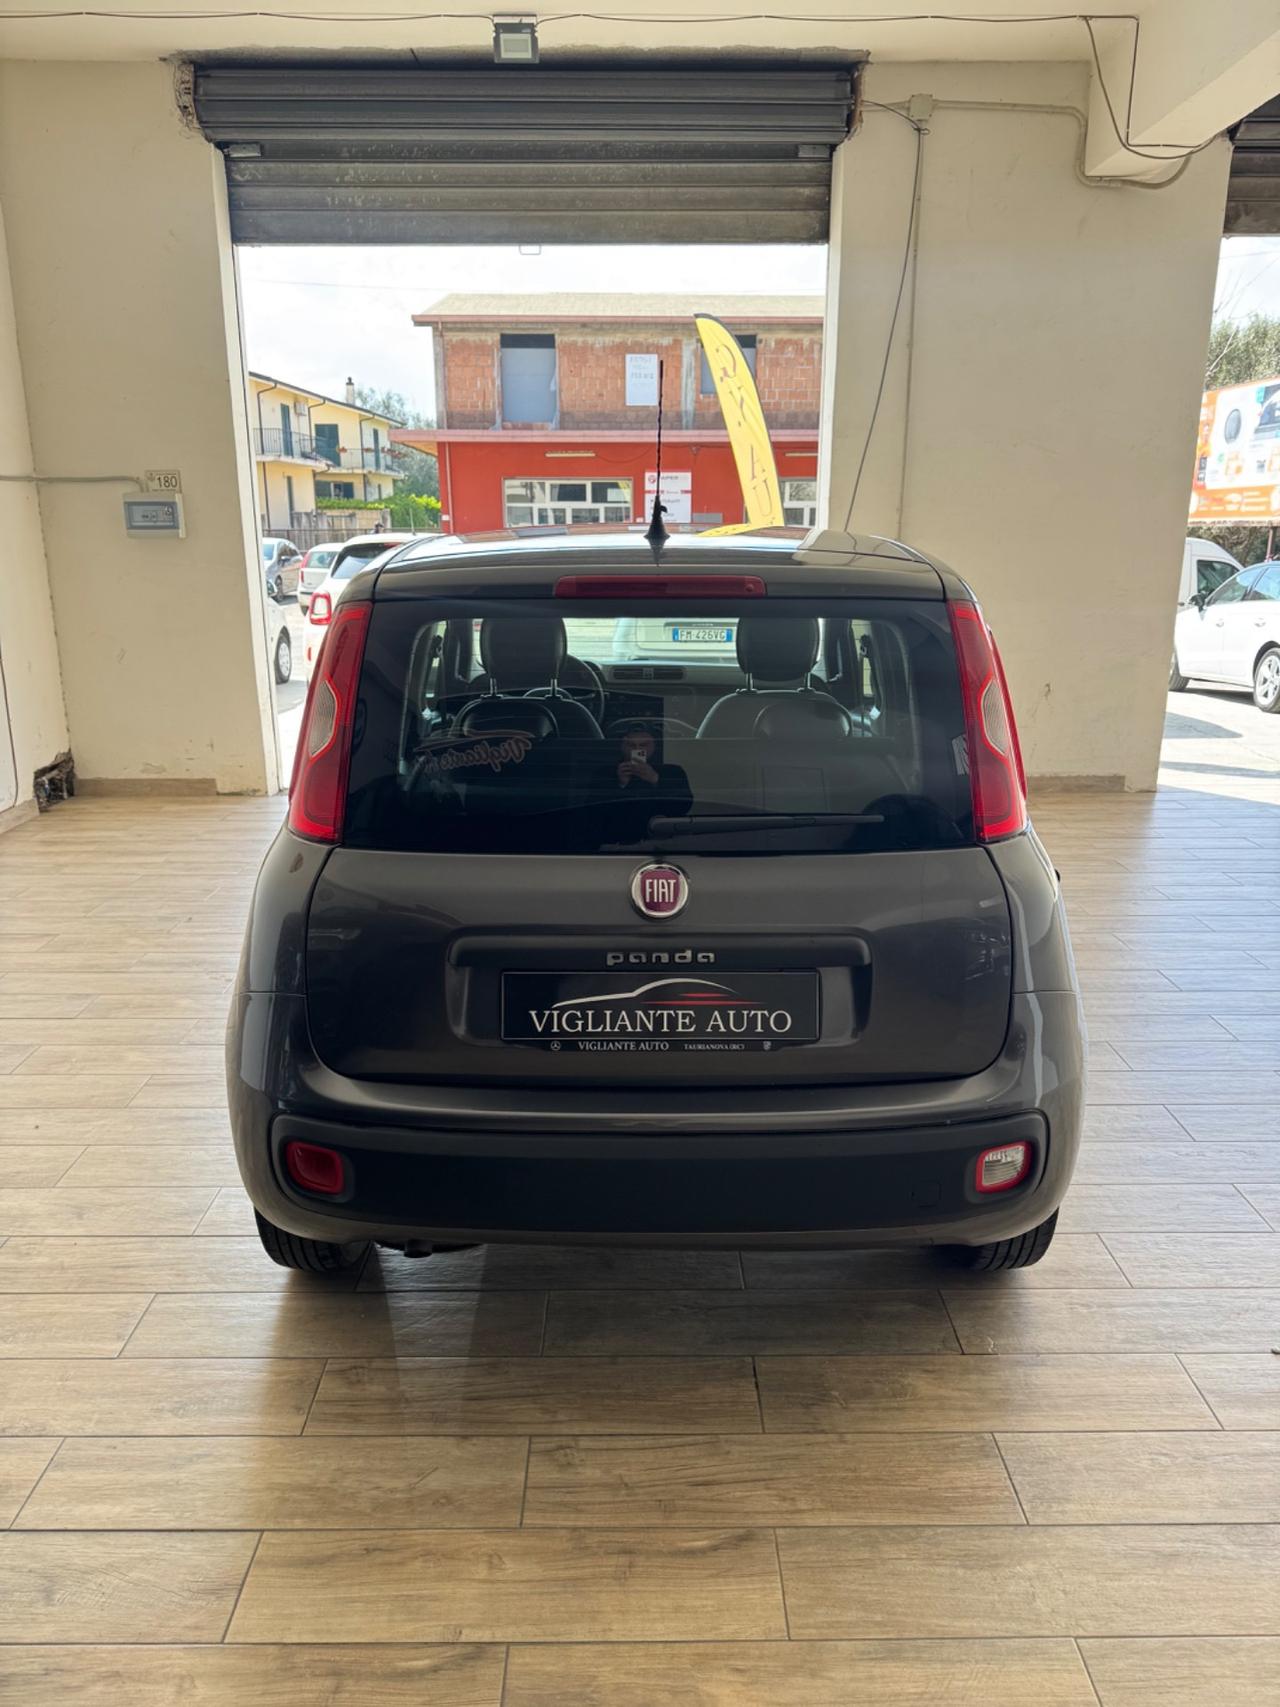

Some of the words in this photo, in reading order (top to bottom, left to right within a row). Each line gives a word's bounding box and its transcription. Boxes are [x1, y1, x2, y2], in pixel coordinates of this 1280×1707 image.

[157, 476, 177, 487] 180
[680, 630, 692, 641] FM
[645, 879, 677, 903] FIAT
[606, 949, 716, 966] panda
[528, 1009, 696, 1033] VIGLIANTE
[707, 1009, 792, 1033] AUTO
[578, 1041, 637, 1051] VIGLIANTE
[638, 1041, 670, 1051] AUTO
